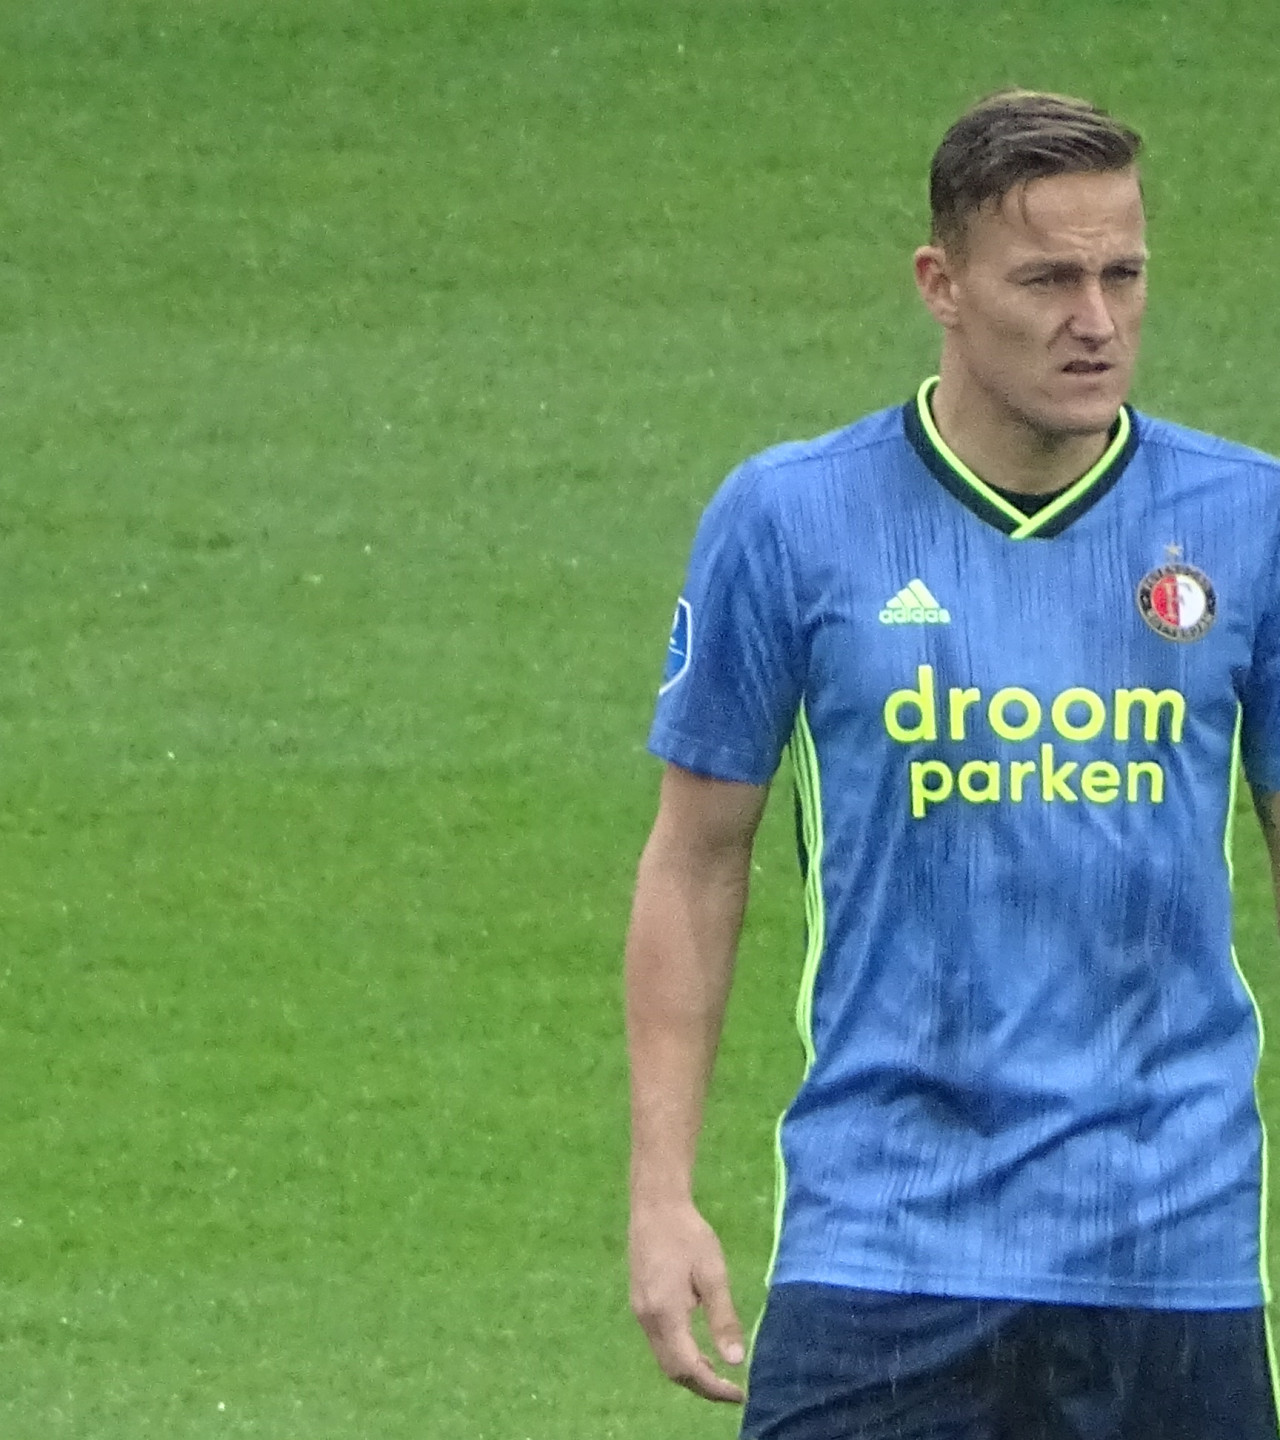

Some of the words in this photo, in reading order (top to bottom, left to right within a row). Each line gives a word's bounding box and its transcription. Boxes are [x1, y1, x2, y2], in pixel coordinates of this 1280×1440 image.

[878, 605, 951, 625] adidas
[883, 663, 1186, 743] droom
[910, 743, 1164, 818] parken
